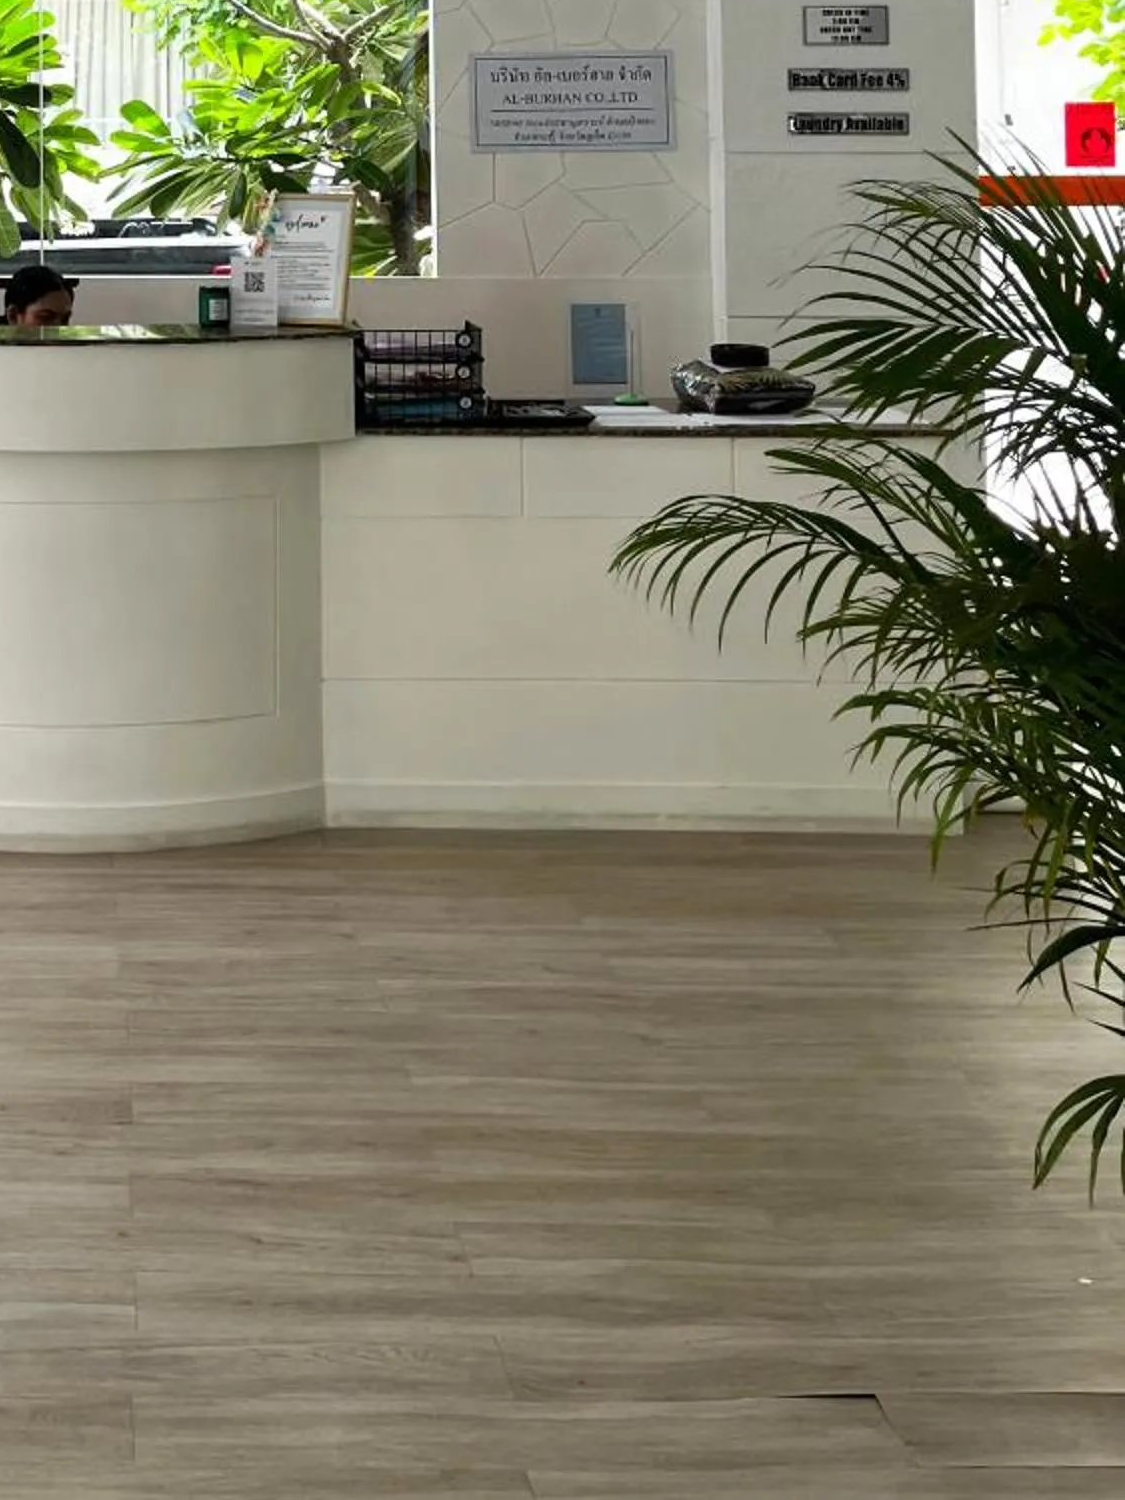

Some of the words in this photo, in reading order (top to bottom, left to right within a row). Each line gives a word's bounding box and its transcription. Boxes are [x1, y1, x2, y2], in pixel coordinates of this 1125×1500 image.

[792, 73, 824, 87] Bank
[828, 72, 858, 87] Card
[860, 73, 884, 87] Fee
[886, 72, 906, 88] 4%
[794, 117, 843, 134] Laundry
[846, 117, 905, 131] Available
